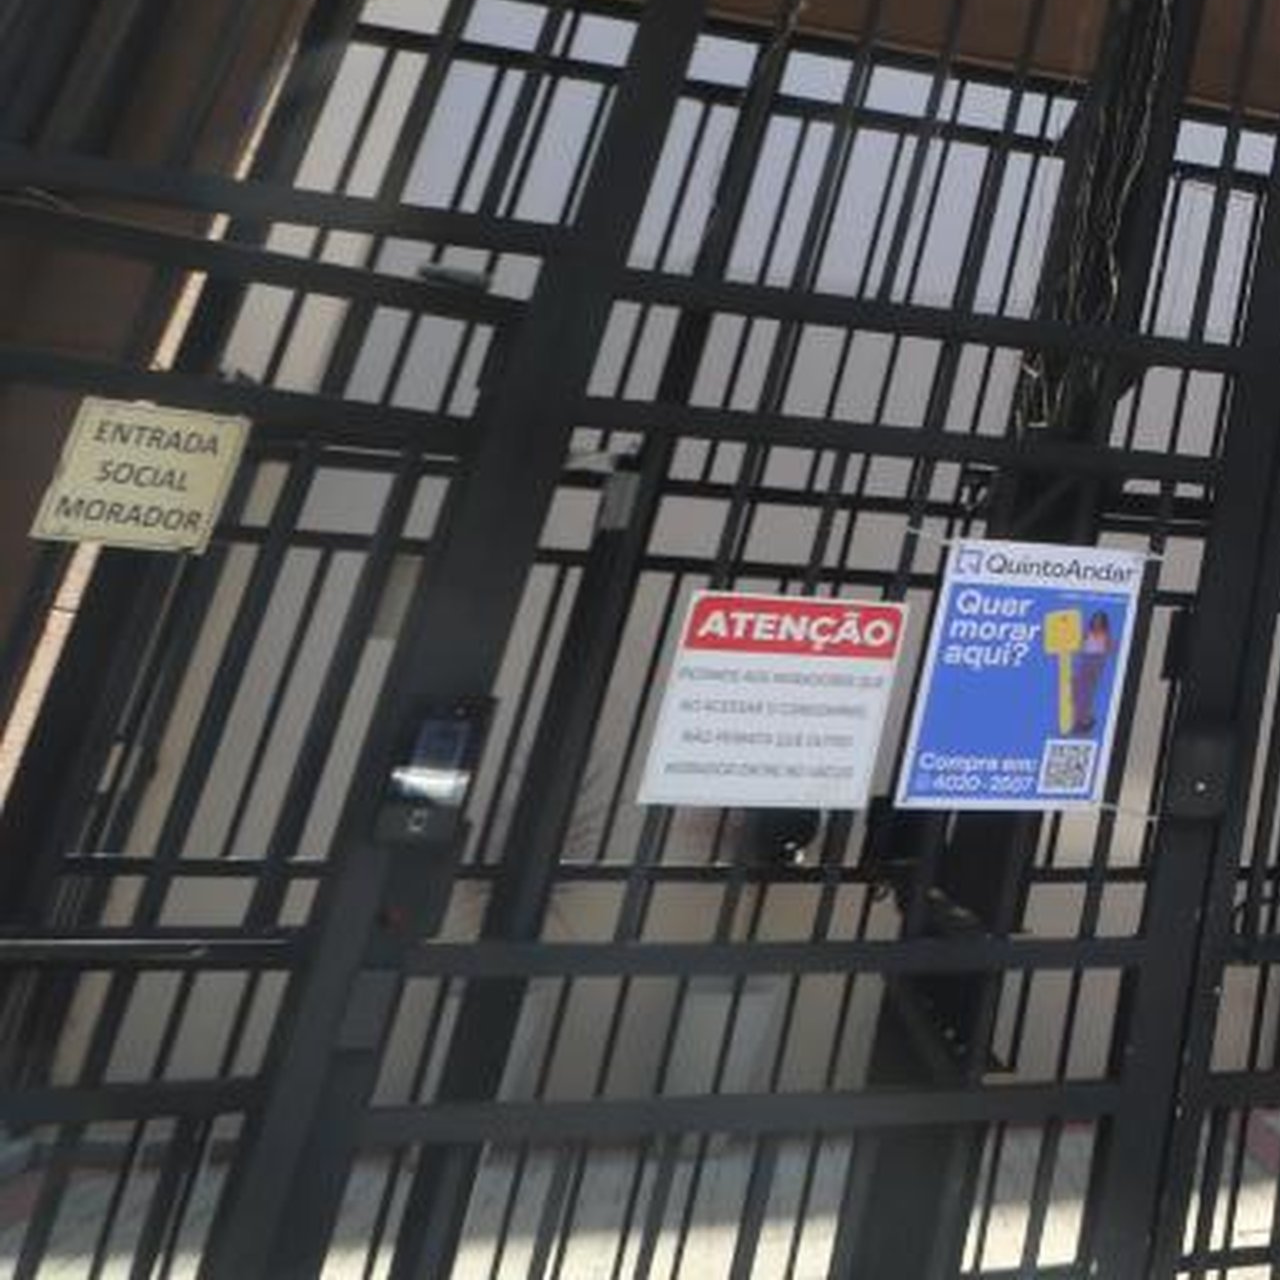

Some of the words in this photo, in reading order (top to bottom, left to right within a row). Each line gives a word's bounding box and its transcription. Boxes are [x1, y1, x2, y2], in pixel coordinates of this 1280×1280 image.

[93, 421, 219, 456] ENTRADA
[95, 460, 188, 492] SOCIAL
[55, 495, 204, 532] MORADOR
[986, 552, 1134, 583] QuintoAndar
[956, 588, 1035, 617] Quer
[698, 609, 893, 651] ATENÇÃO
[949, 618, 1041, 642] morar
[943, 641, 1029, 671] aqui?
[918, 752, 999, 775] Compra
